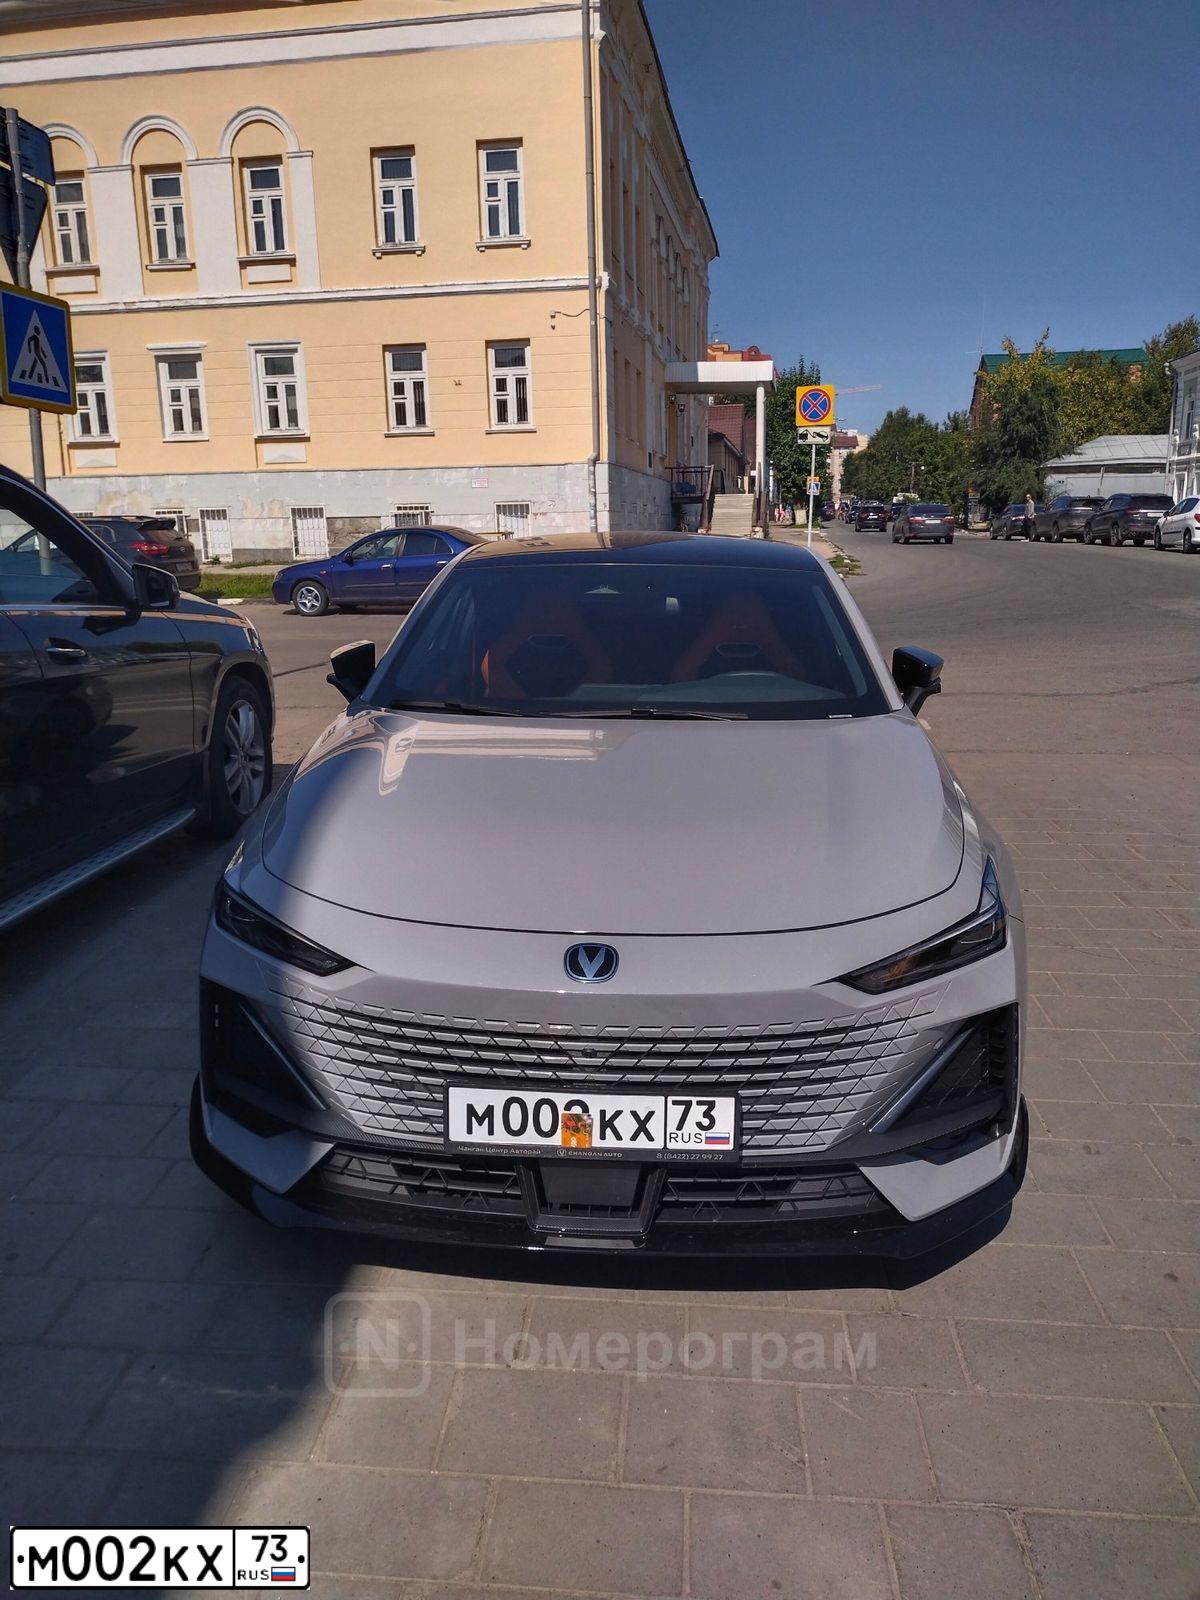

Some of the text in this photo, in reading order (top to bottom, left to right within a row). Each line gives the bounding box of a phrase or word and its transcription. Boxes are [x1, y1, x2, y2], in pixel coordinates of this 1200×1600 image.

[671, 1099, 717, 1132] 73
[668, 1132, 703, 1144] RUS
[485, 1146, 508, 1155] Центр
[663, 1153, 691, 1161] (8422)
[691, 1153, 701, 1161] 27
